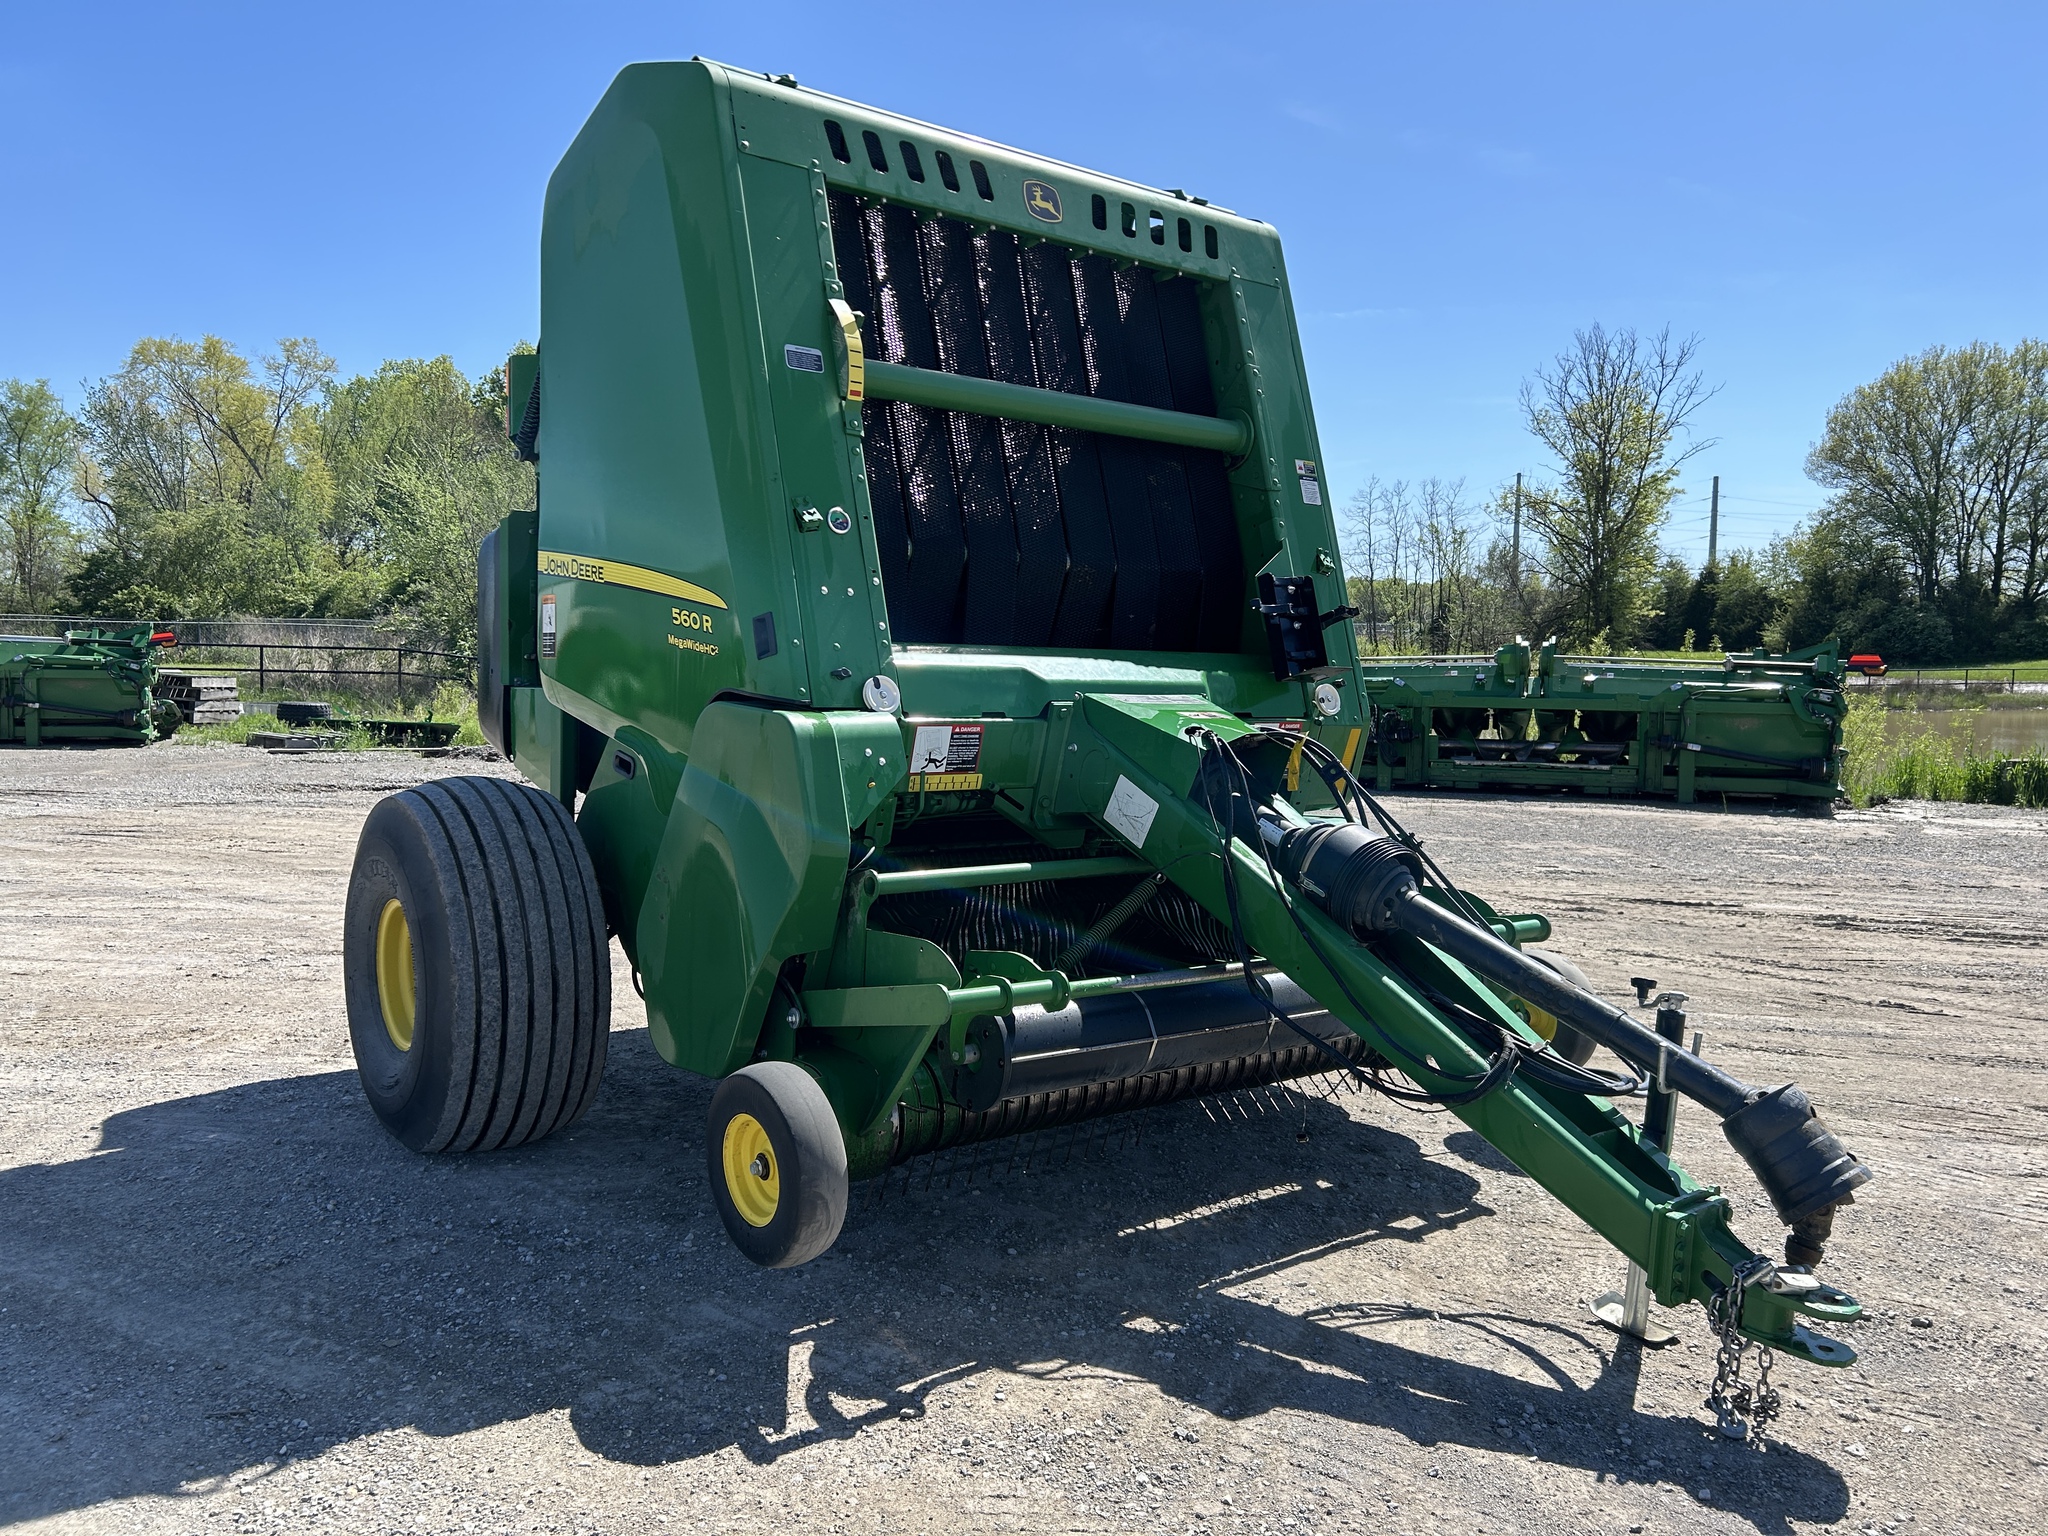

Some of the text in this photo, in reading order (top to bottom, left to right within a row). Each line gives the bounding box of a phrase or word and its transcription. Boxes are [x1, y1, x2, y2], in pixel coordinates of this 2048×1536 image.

[543, 555, 604, 580] JOHN DEERE
[671, 607, 713, 634] 560 R
